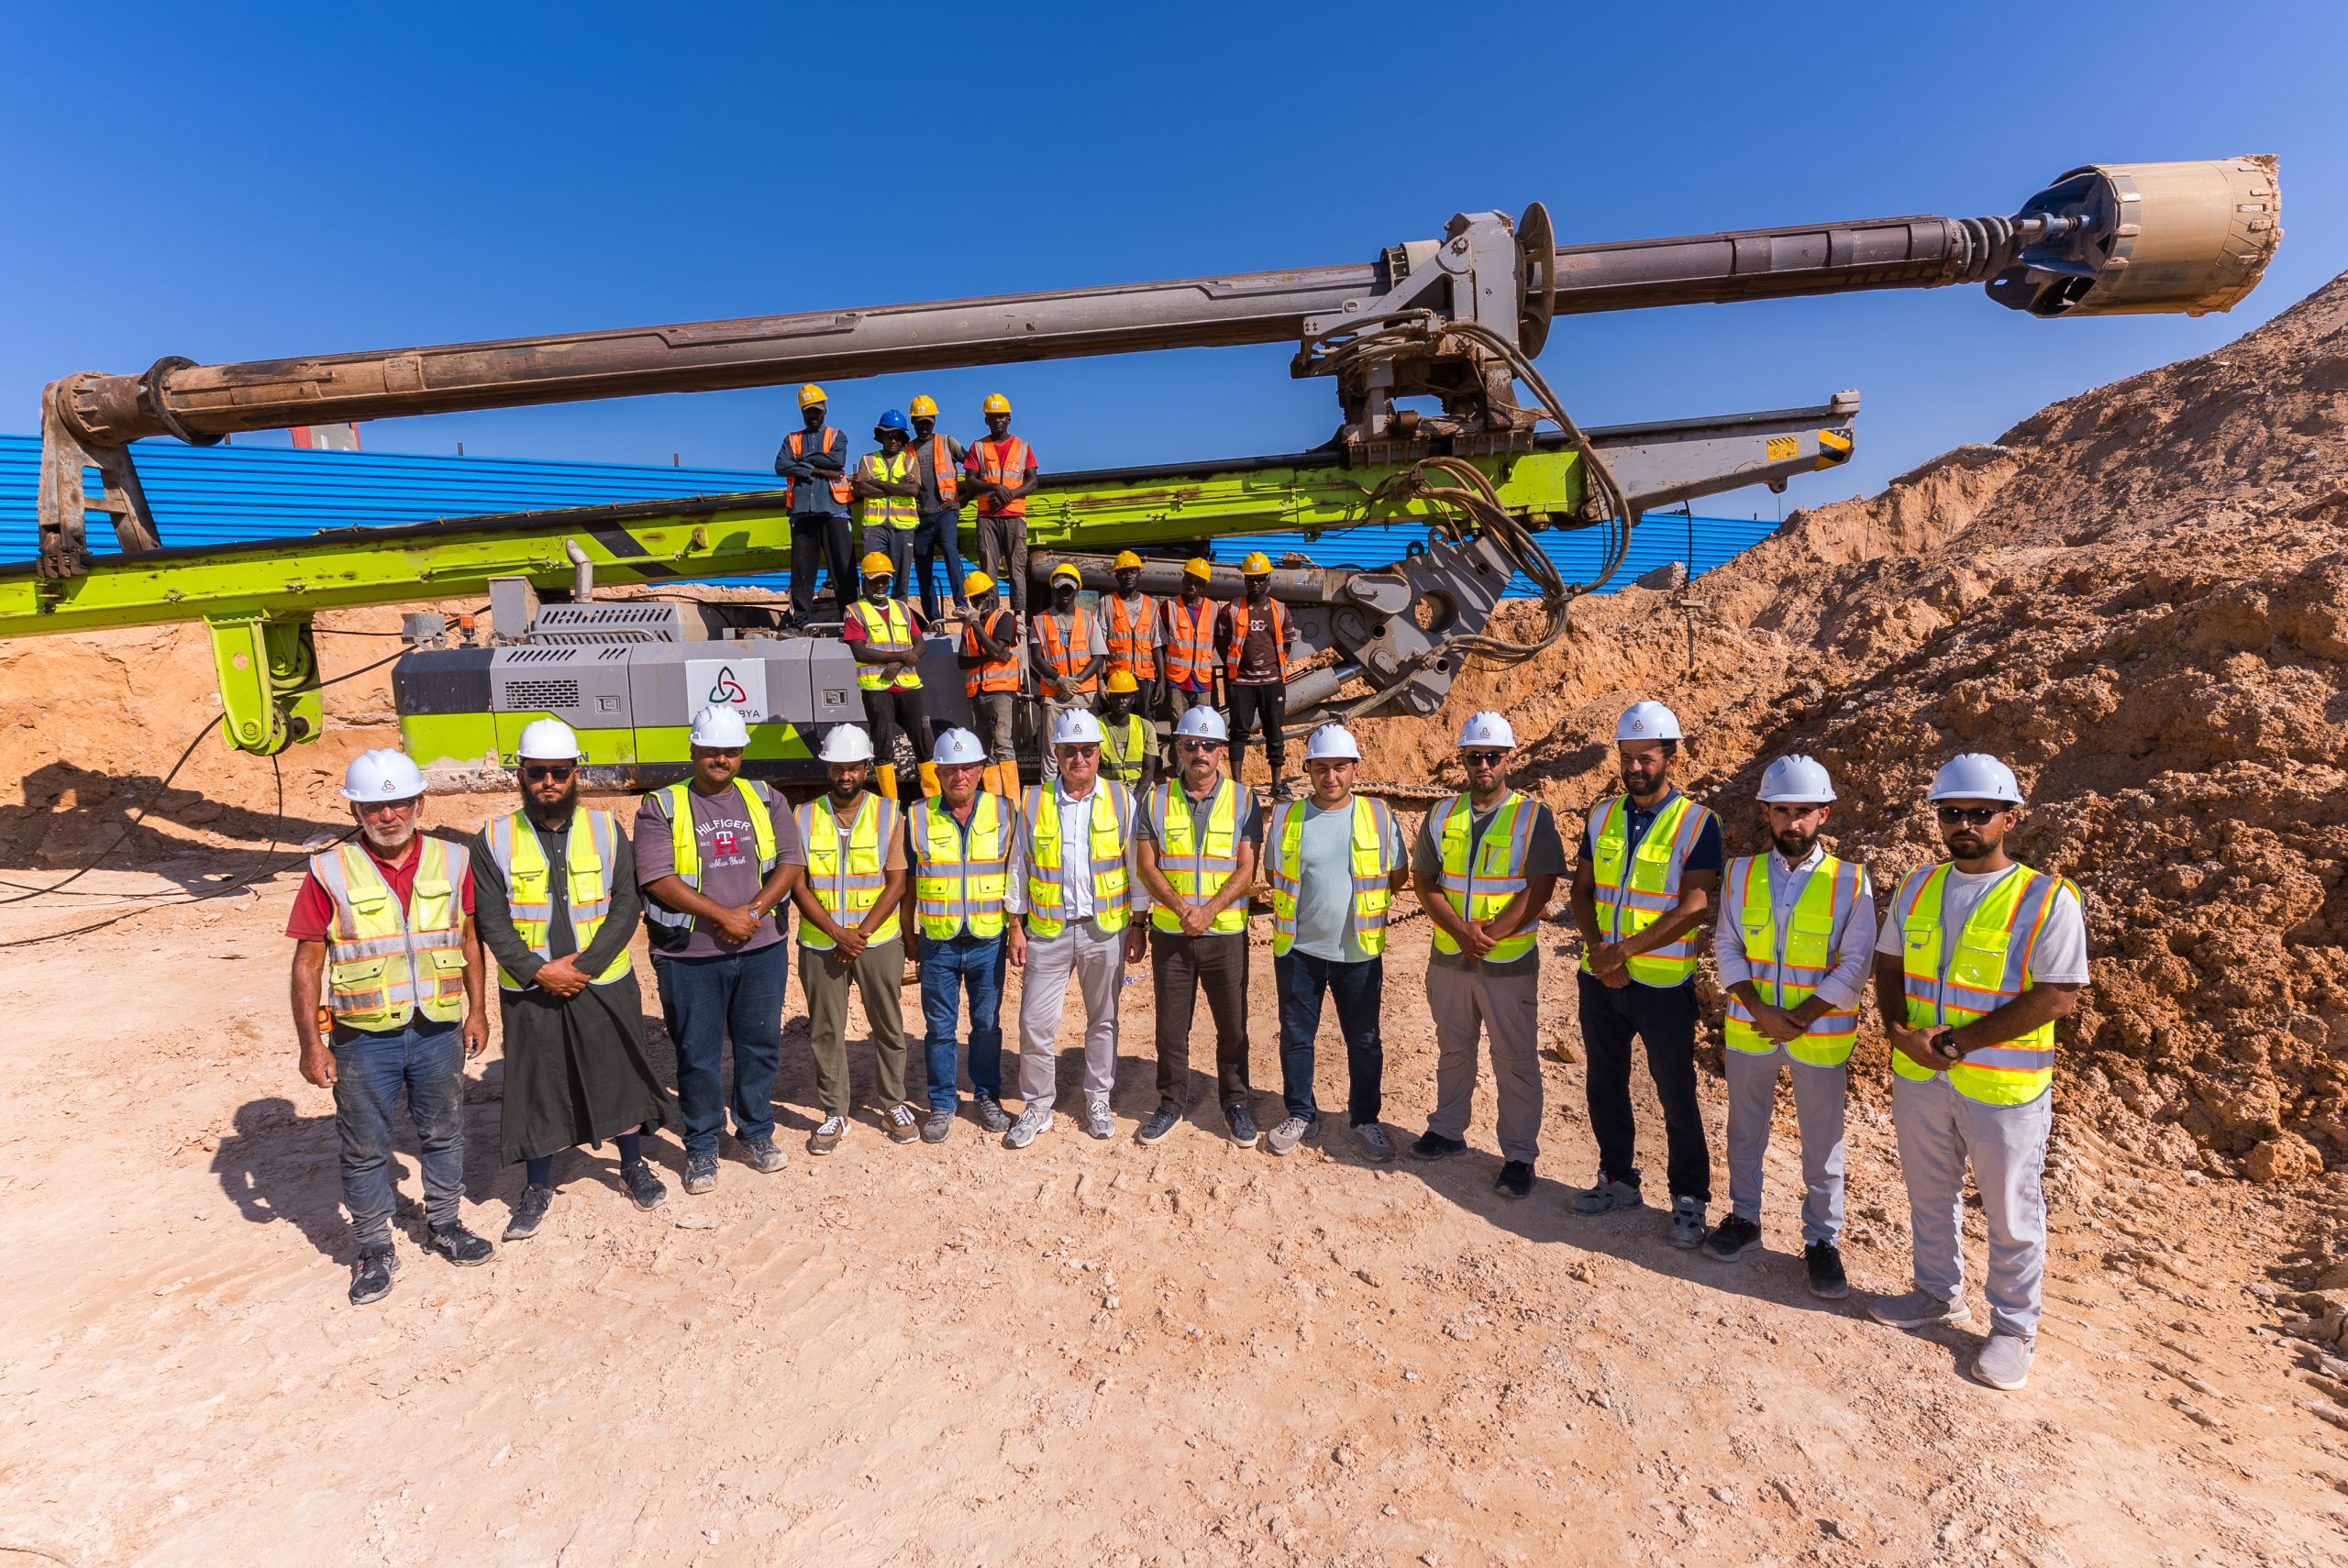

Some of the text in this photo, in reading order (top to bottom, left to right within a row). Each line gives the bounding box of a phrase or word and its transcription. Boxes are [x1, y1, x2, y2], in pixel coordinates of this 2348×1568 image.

[738, 710, 760, 718] BYA
[695, 819, 751, 836] HILFIGER
[709, 856, 747, 868] New York
